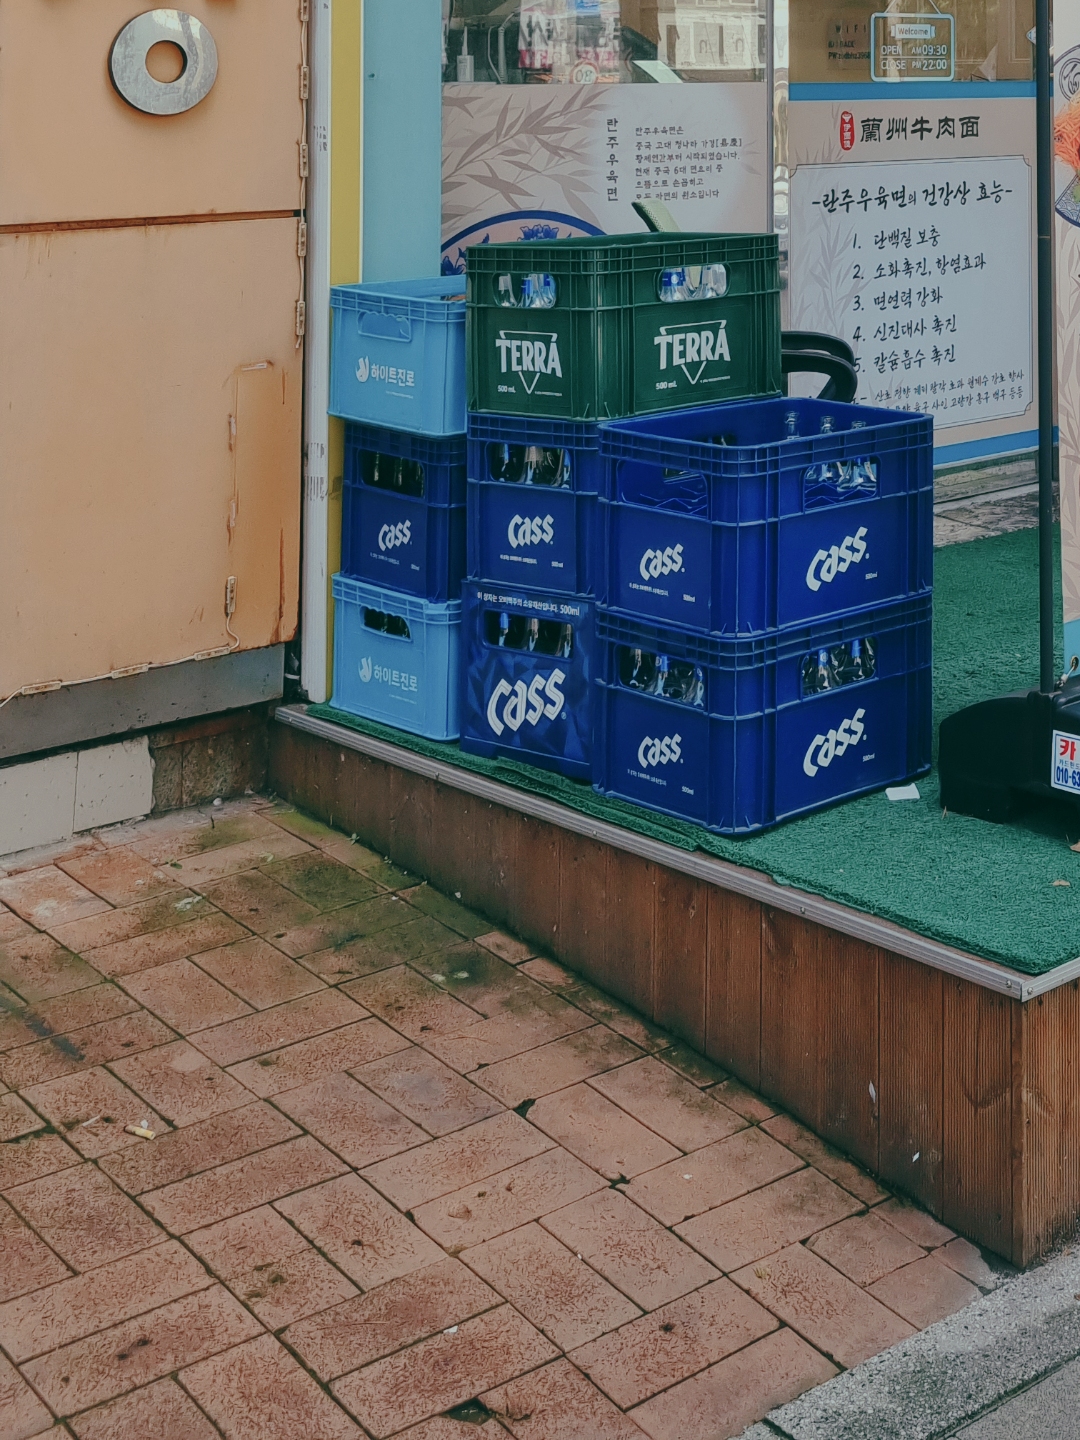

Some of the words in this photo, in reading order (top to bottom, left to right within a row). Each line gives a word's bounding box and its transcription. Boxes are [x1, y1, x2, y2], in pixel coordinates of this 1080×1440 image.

[897, 26, 929, 36] Welcome
[880, 45, 902, 55] OPEN
[880, 60, 906, 70] CLOSE
[860, 115, 981, 143] 蘭州牛肉面
[655, 140, 672, 150] 고대
[606, 117, 619, 202] 란주우육면
[635, 166, 651, 177] 현재
[654, 166, 670, 176] 중국
[674, 165, 687, 175] 6대
[922, 180, 971, 208] 건강상
[852, 232, 861, 249] 1.
[873, 227, 913, 250] 단백질
[916, 224, 941, 247] 보충
[852, 264, 864, 279] 2.
[935, 252, 987, 276] 항염효과
[852, 295, 864, 311] 3.
[916, 286, 943, 308] 강화
[852, 326, 866, 342] 4.
[873, 317, 927, 342] 신진대사
[931, 314, 957, 334] 촉진
[495, 338, 563, 378] TERRA
[653, 328, 732, 371] TERRA
[853, 356, 866, 374] 5.
[873, 348, 926, 374] 칼슘흡수
[930, 344, 956, 364] 촉진
[371, 363, 415, 387] 하이트진로
[655, 381, 667, 390] 500
[378, 519, 412, 552] Cass
[507, 514, 555, 549] Cass
[639, 543, 685, 582] Cass
[805, 526, 869, 592] Cass
[559, 604, 580, 616] 500ml
[373, 664, 418, 693] 하이트진로
[486, 667, 567, 737] Cass
[637, 733, 683, 769] Cass
[802, 707, 866, 778] Cass
